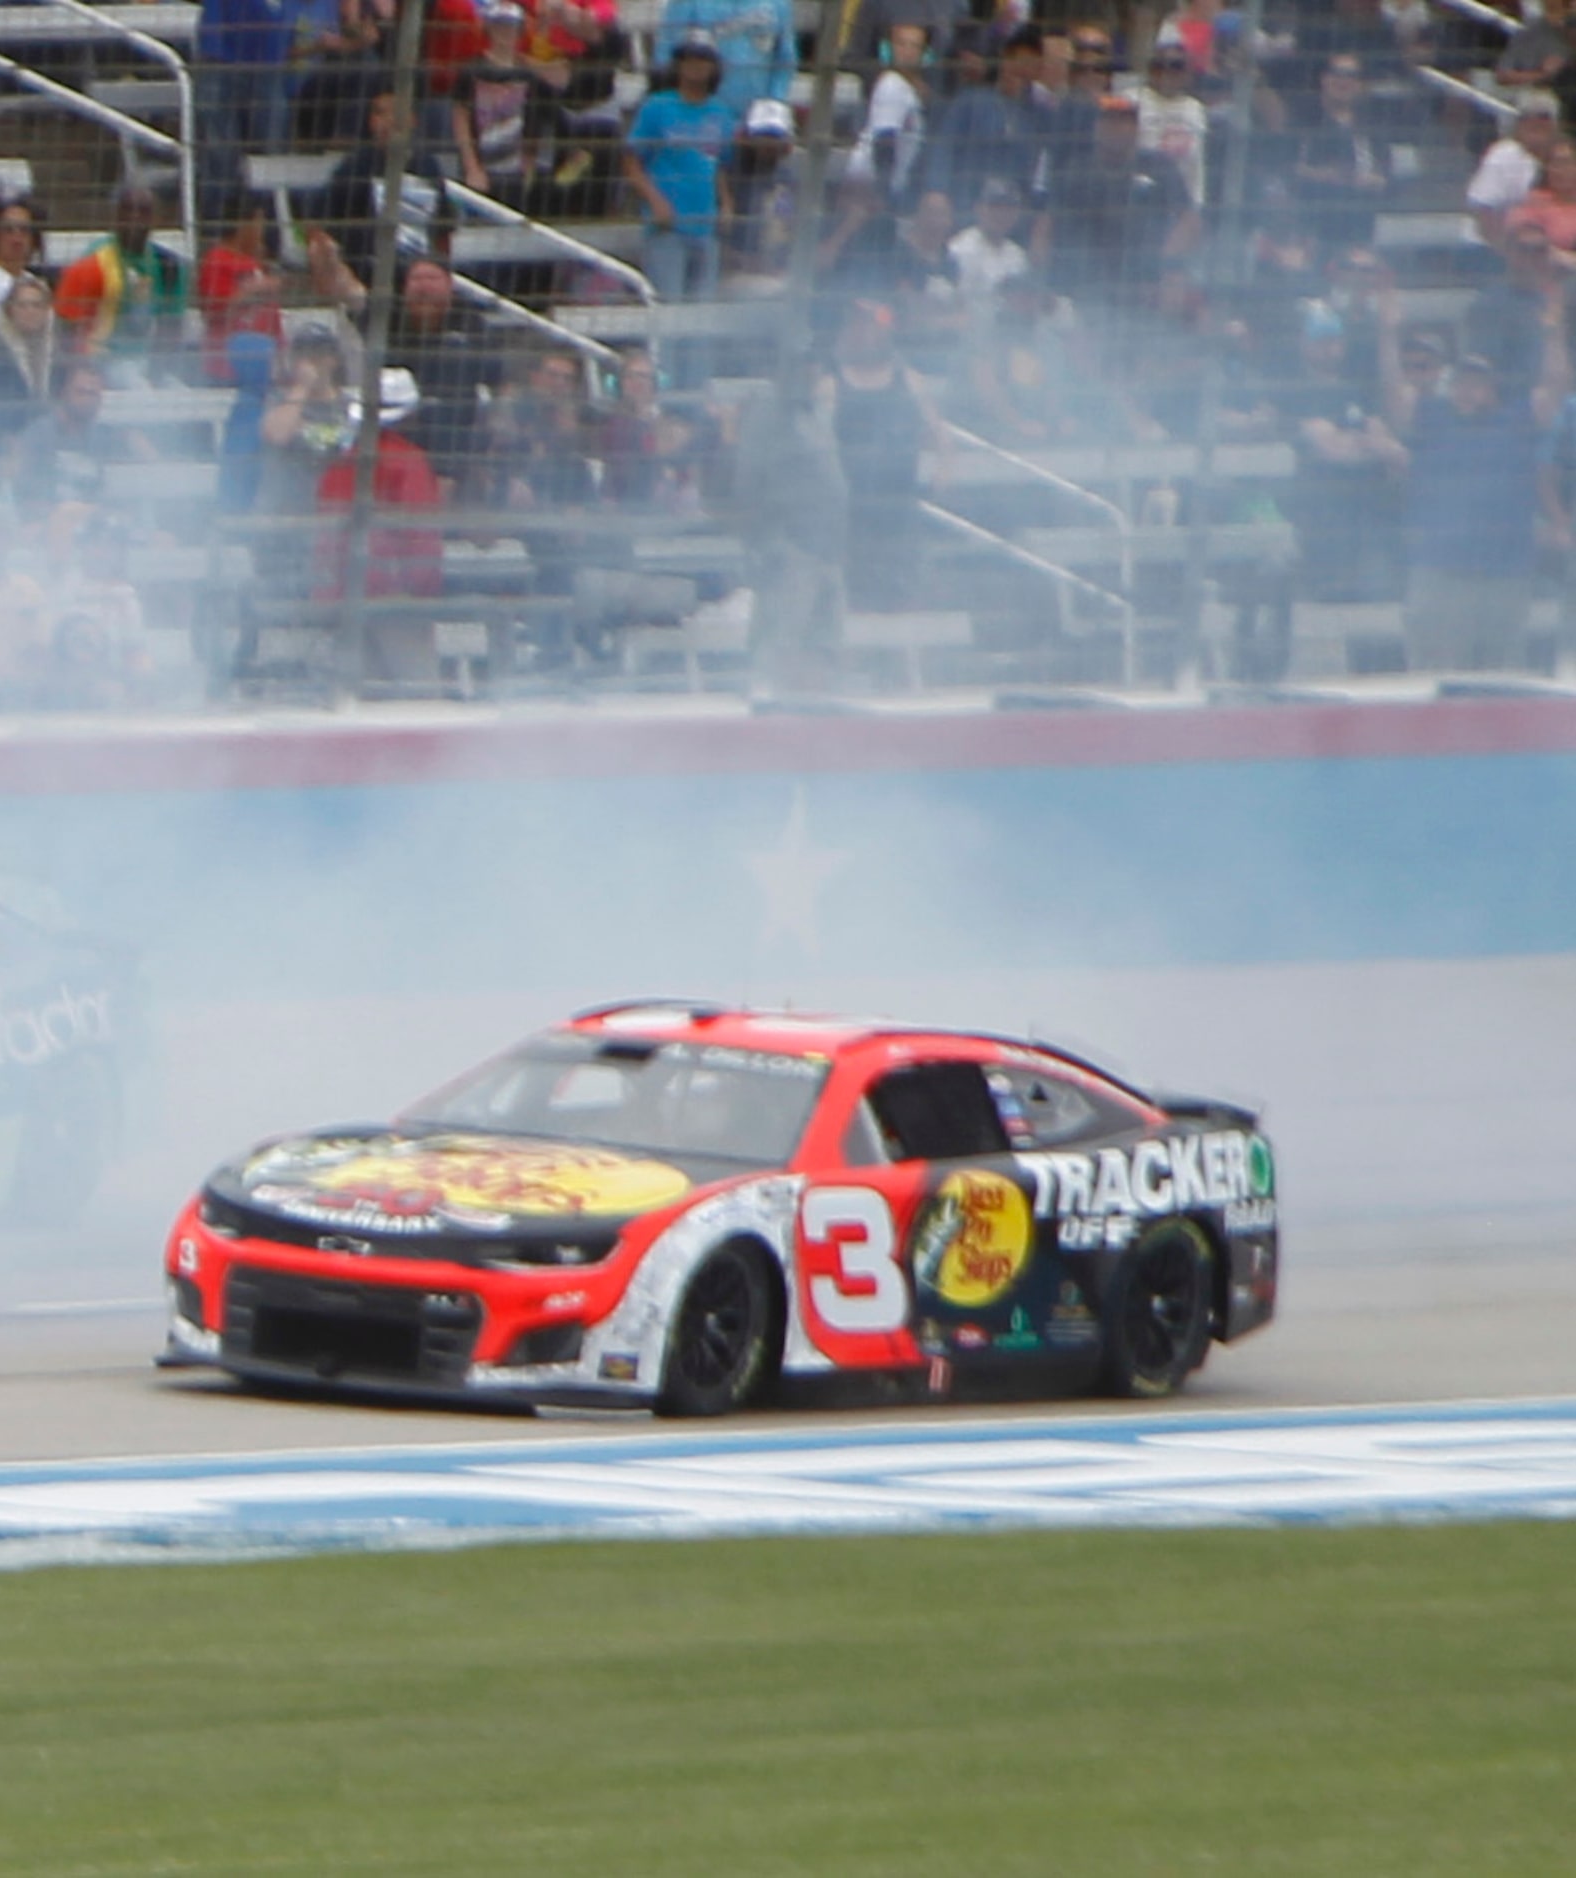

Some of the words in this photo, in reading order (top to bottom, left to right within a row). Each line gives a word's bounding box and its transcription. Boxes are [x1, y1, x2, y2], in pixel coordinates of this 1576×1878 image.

[1013, 1130, 1248, 1219] TRACKER
[178, 1238, 198, 1272] 3
[802, 1186, 910, 1331] 3
